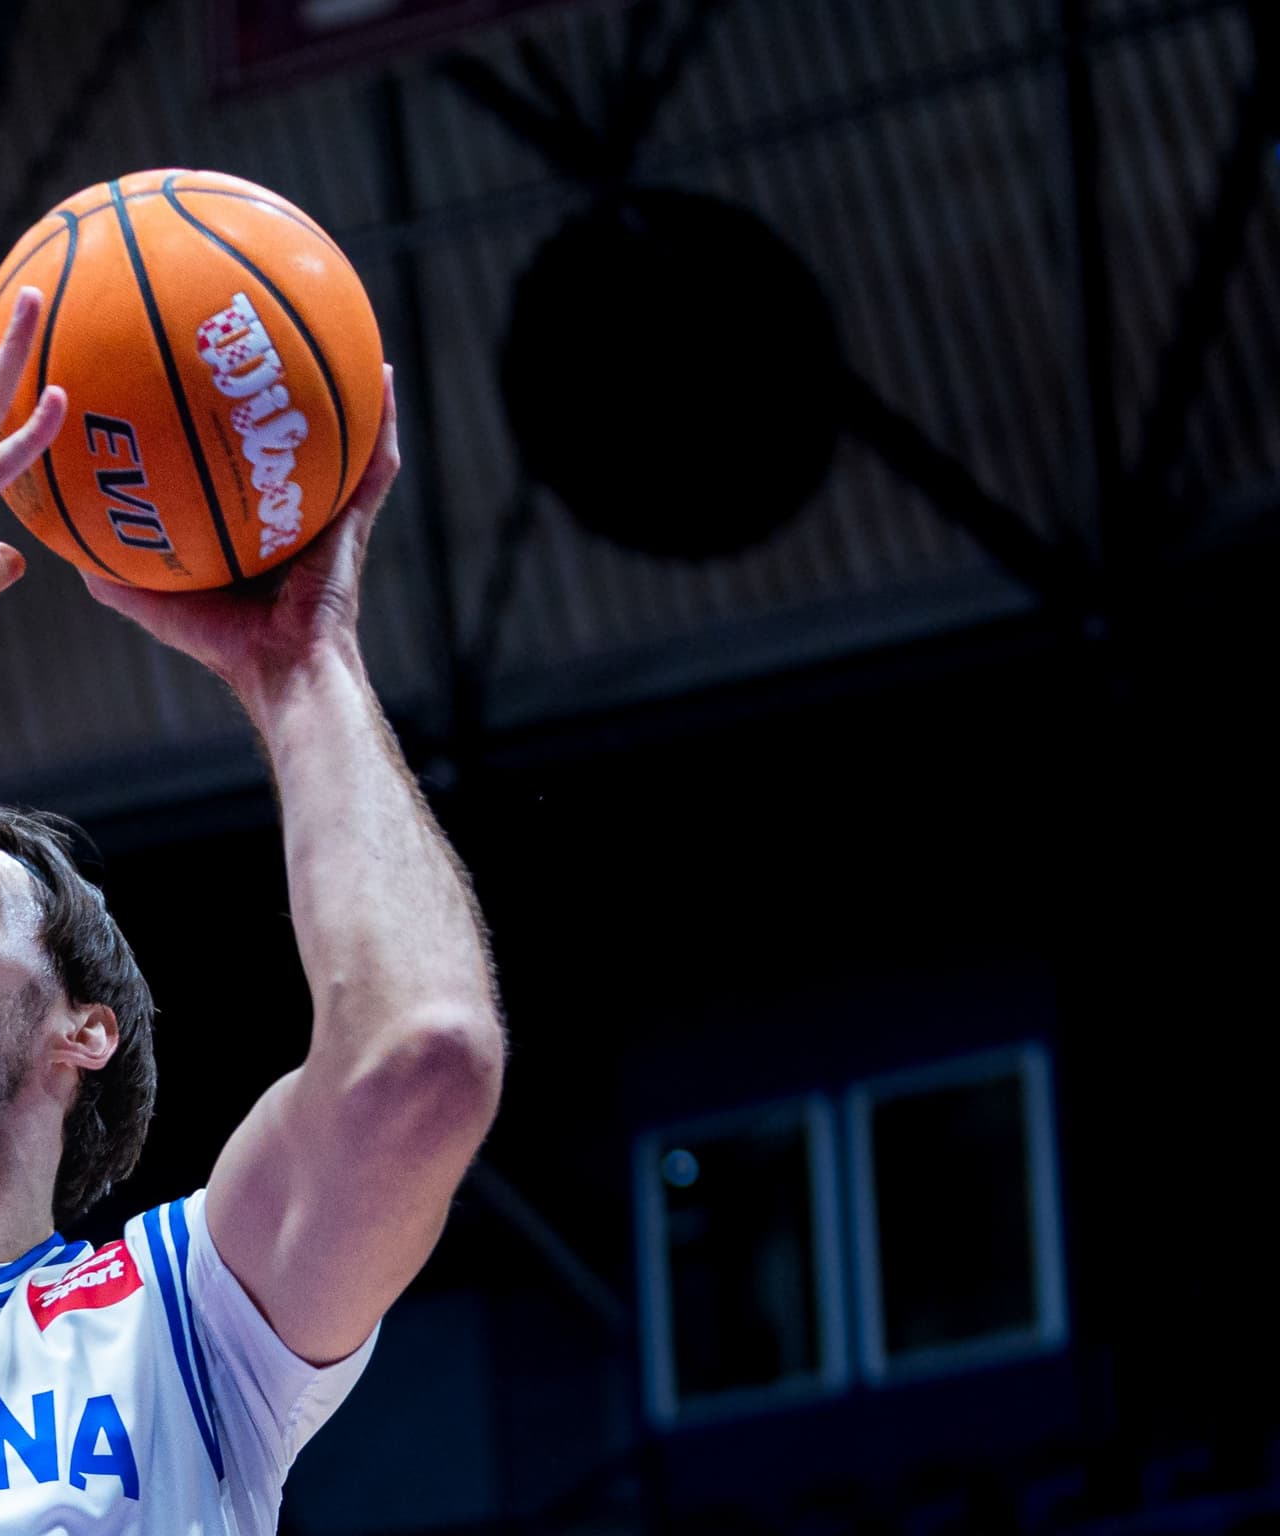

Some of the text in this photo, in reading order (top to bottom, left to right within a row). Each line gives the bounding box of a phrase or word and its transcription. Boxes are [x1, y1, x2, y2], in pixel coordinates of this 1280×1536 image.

[83, 411, 173, 552] EVO
[197, 292, 308, 559] Wilson
[41, 1260, 124, 1308] sport
